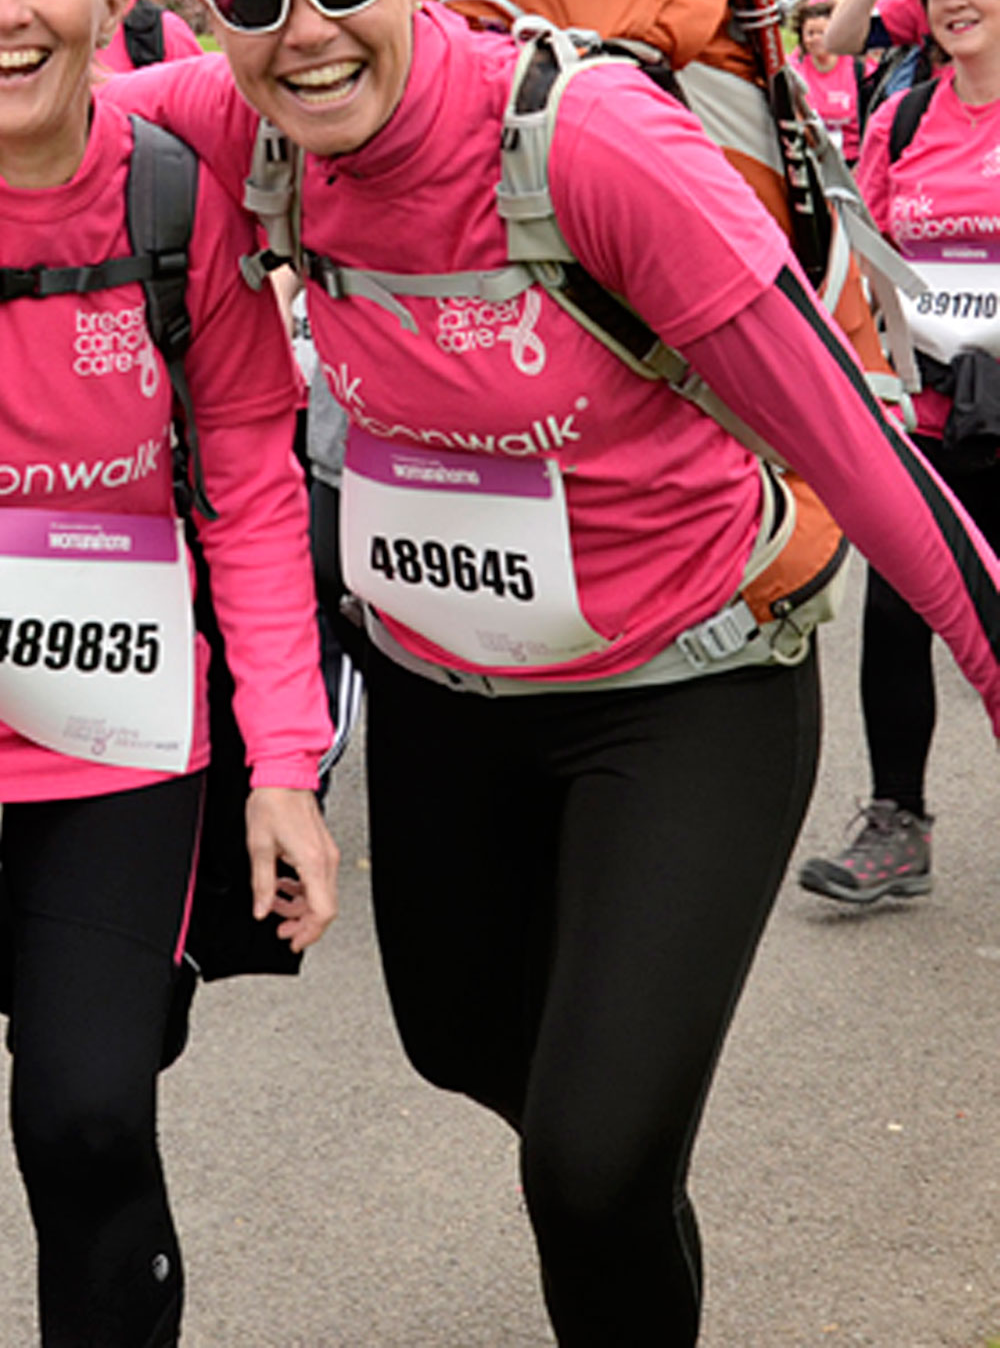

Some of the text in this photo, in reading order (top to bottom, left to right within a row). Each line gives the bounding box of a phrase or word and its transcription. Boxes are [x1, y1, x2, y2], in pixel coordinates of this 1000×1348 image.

[779, 118, 815, 215] LEKI
[73, 352, 133, 376] care
[436, 328, 495, 354] care
[370, 536, 535, 602] 489645
